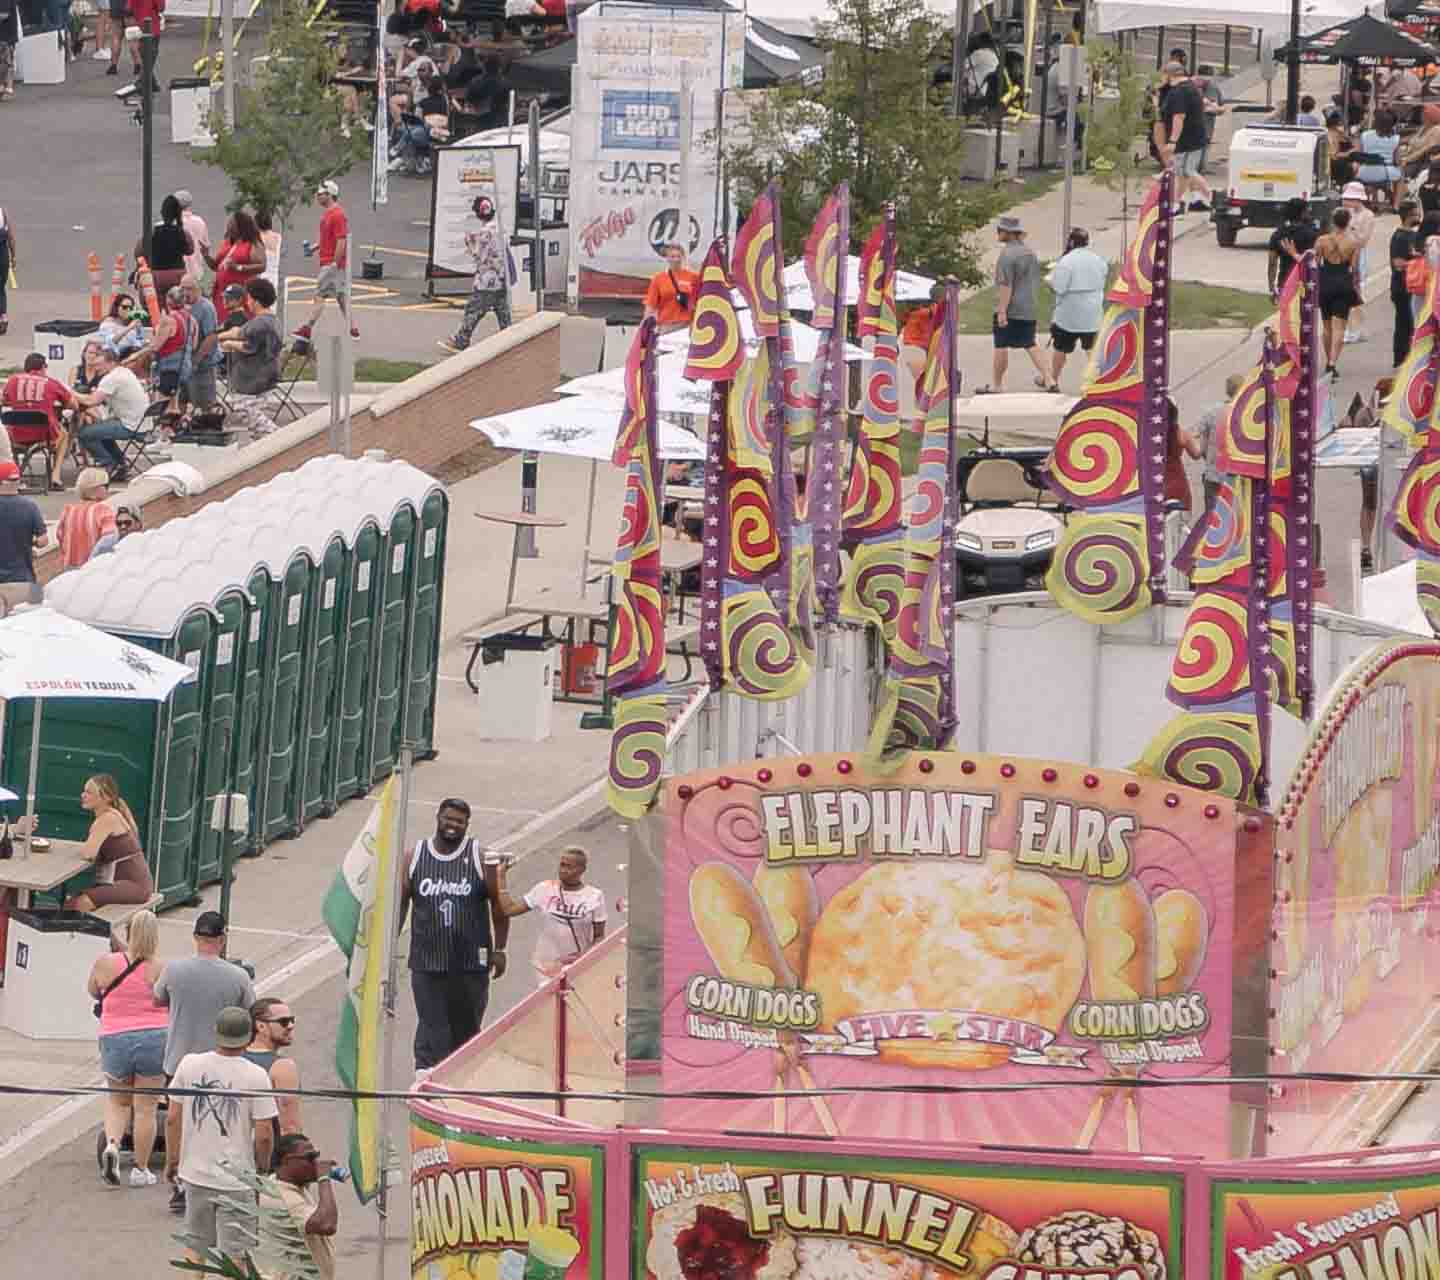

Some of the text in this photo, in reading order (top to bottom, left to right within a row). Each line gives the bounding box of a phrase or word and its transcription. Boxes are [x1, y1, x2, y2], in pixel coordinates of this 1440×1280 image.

[616, 119, 681, 138] LIGHT
[623, 103, 671, 120] BUD
[82, 680, 137, 692] TEQUILA
[761, 789, 994, 862] ELEPHANT
[1016, 797, 1137, 881] EARS
[418, 877, 472, 897] Orlando
[439, 899, 453, 928] 1
[687, 974, 820, 1028] CORN DOGS
[1071, 995, 1205, 1038] CORN DOGS
[688, 1015, 779, 1049] Hand Dipped
[961, 1016, 1047, 1050] STAR
[1151, 1037, 1203, 1063] Dipped
[643, 1177, 674, 1209] Hot
[693, 1162, 742, 1194] Fresh
[745, 1172, 977, 1266] FUNNEL
[1231, 1192, 1402, 1274] Fresh Squeezed
